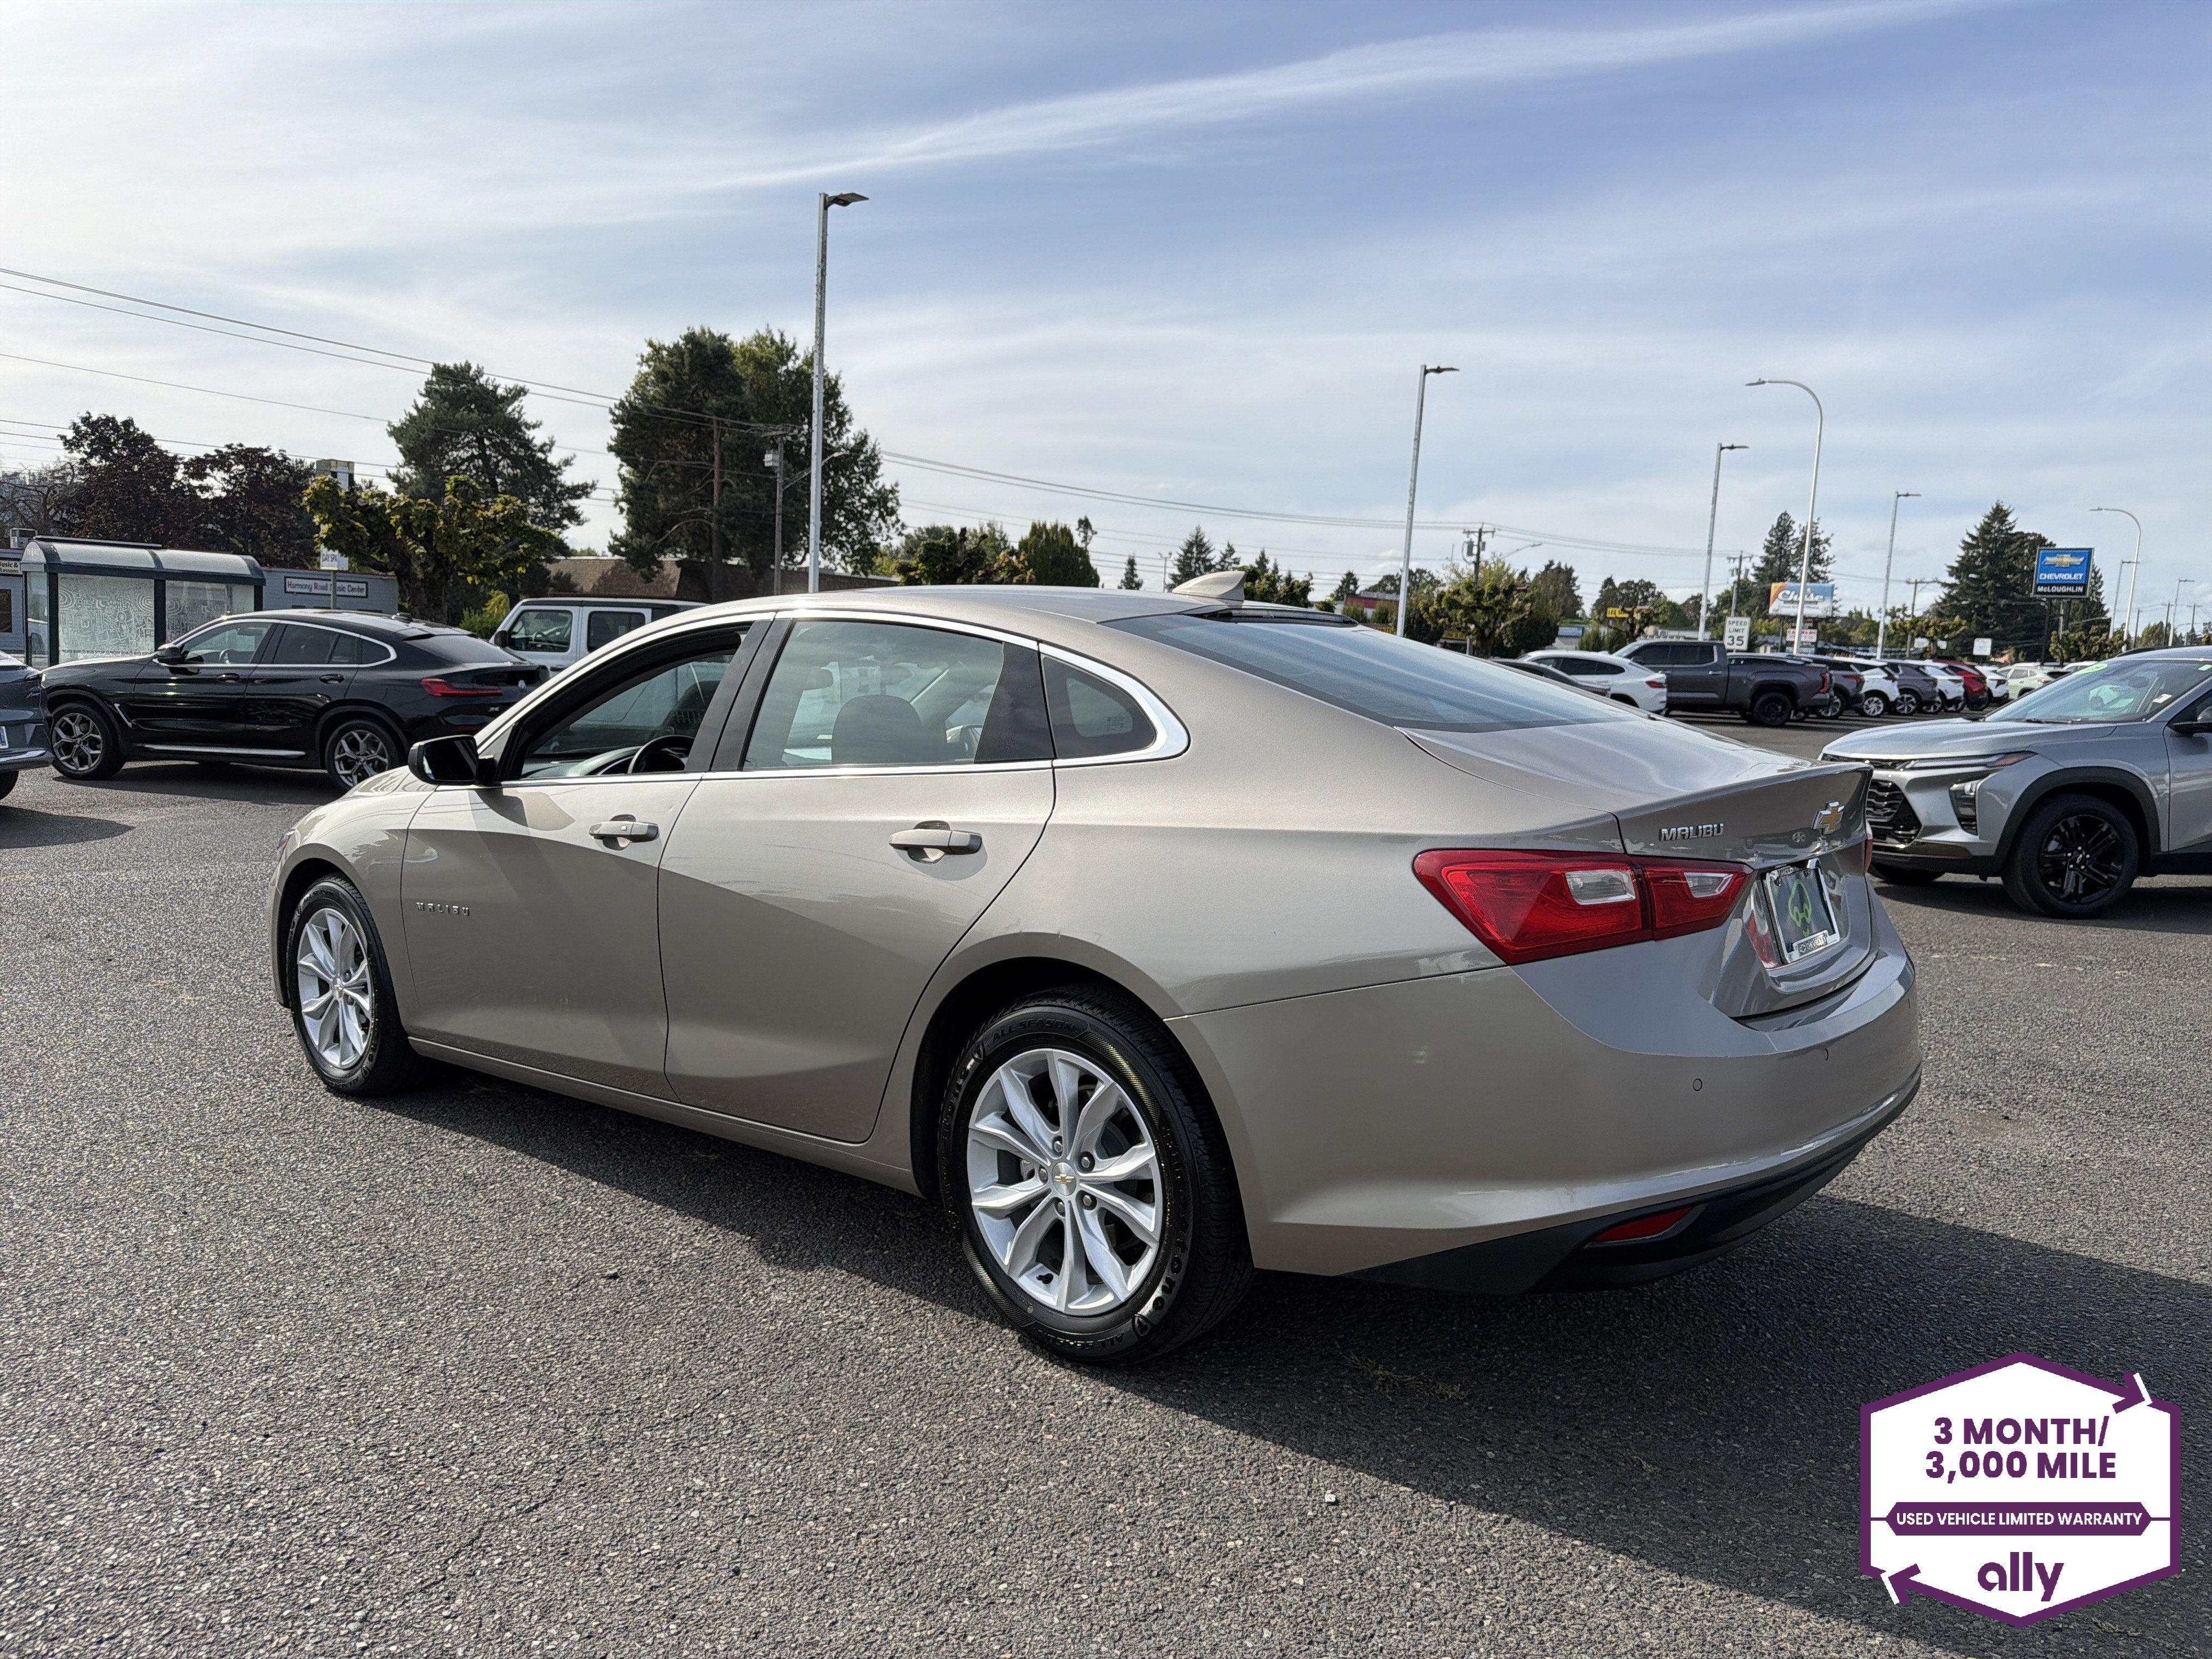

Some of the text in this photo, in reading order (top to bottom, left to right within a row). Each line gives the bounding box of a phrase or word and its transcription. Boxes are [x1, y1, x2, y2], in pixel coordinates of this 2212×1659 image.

[287, 580, 313, 592] Harmony
[314, 582, 328, 591] Road
[347, 584, 365, 592] Center
[1727, 635, 1744, 646] 35
[1659, 823, 1724, 841] MALIBU
[416, 902, 470, 916] MALIBU
[992, 1024, 1015, 1042] ALL
